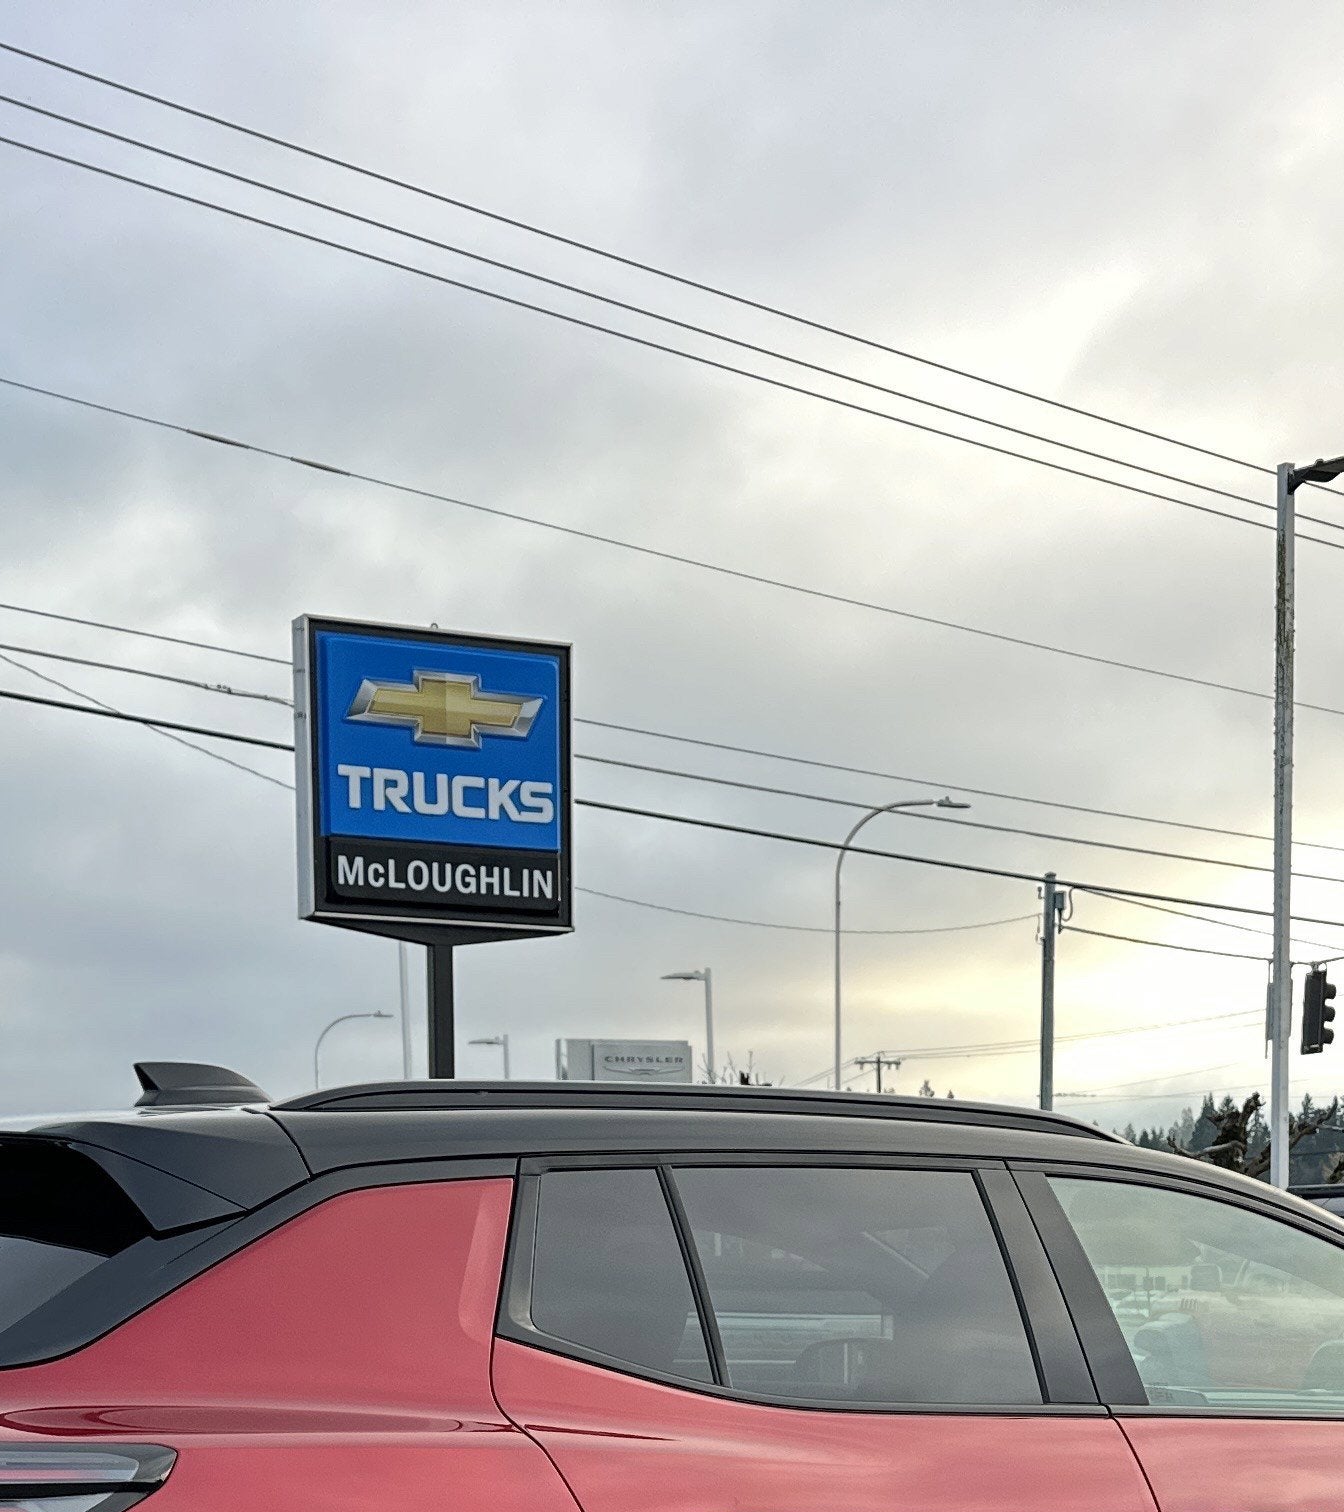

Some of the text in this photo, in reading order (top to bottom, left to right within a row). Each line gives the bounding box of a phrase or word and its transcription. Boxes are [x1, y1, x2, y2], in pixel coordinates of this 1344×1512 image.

[337, 764, 554, 824] TRUCKS
[337, 855, 553, 900] McLOUGHLIN
[604, 1056, 684, 1064] CHRYSLER
